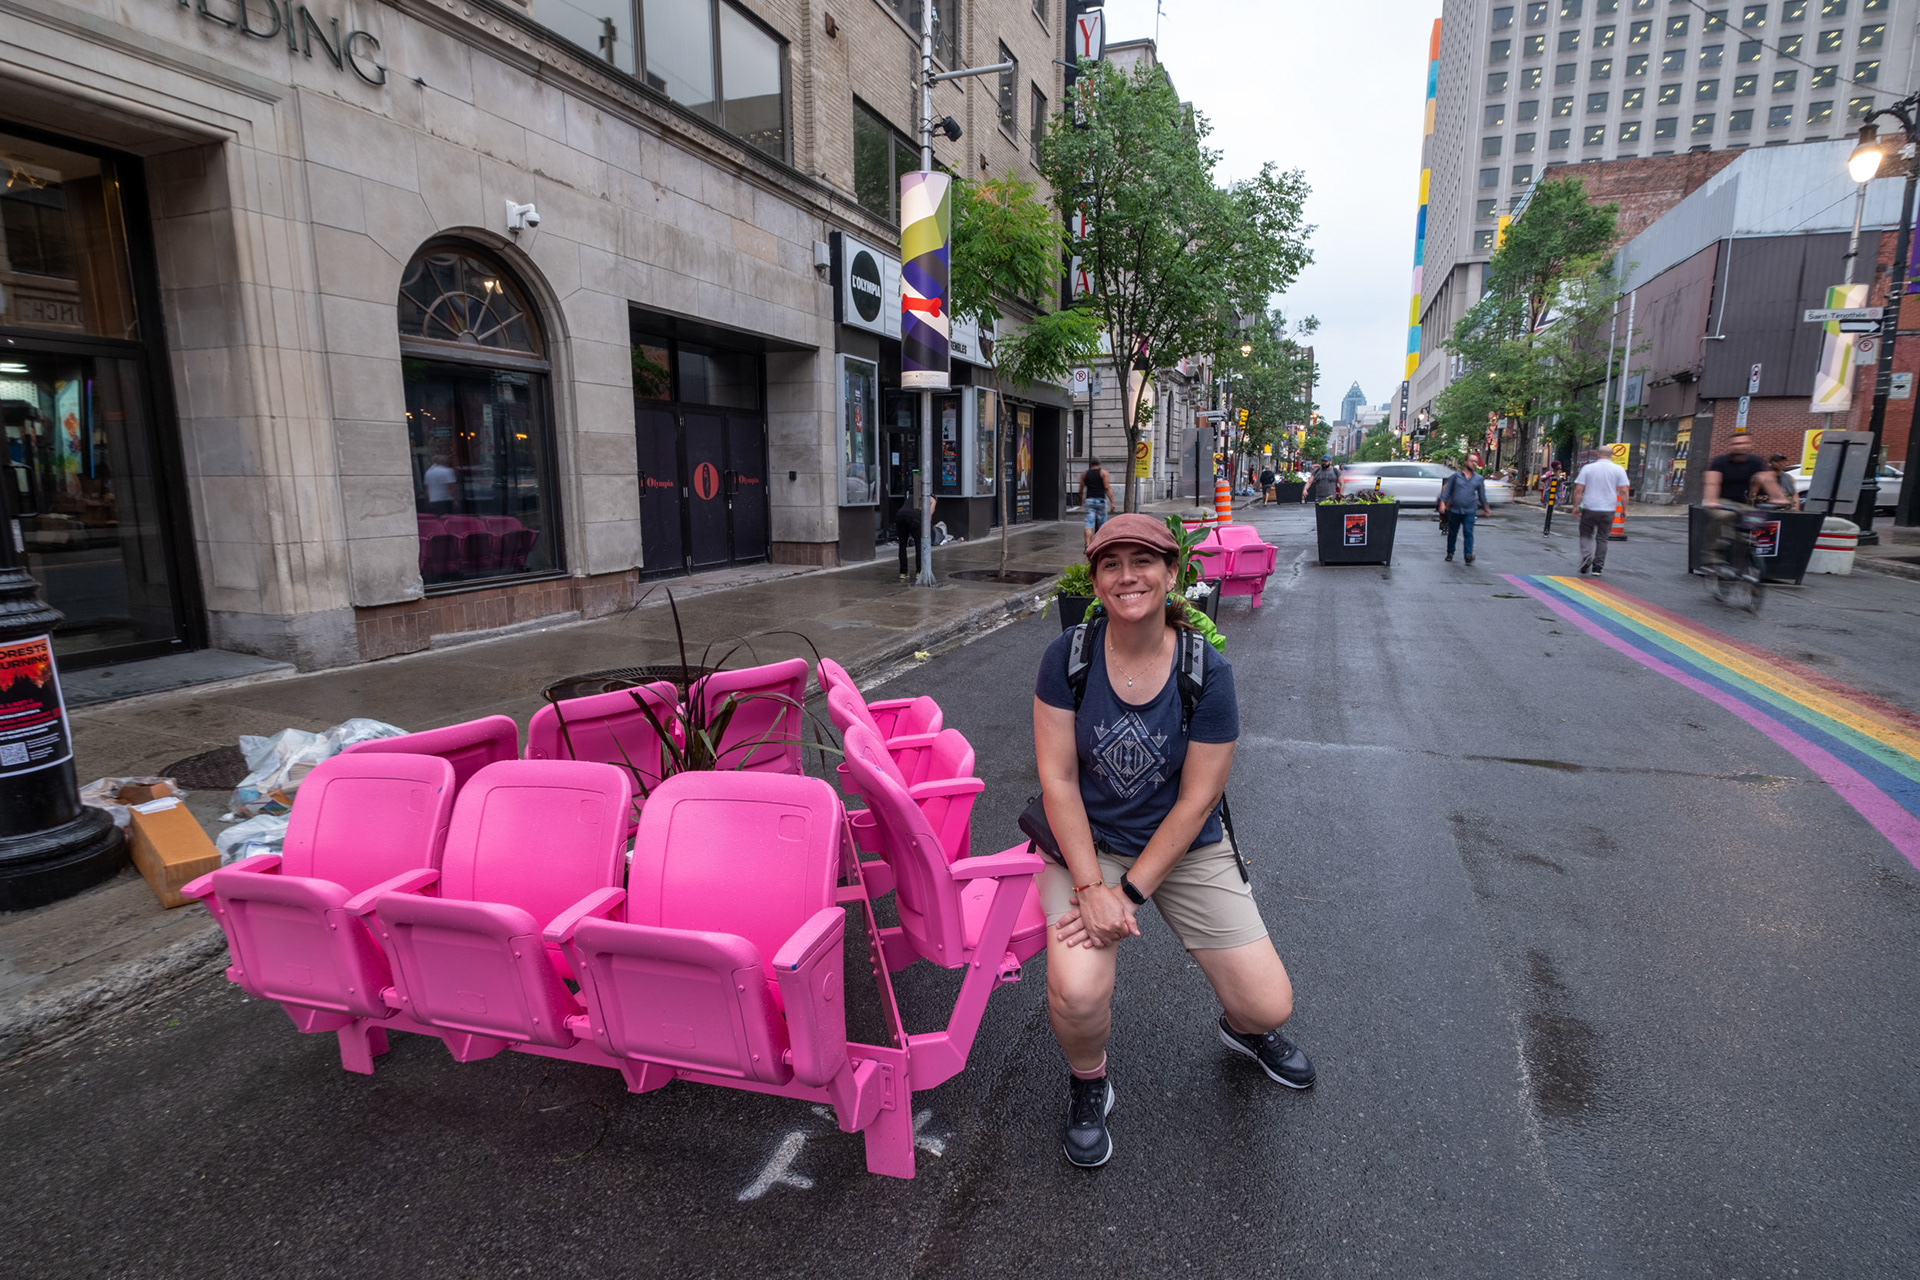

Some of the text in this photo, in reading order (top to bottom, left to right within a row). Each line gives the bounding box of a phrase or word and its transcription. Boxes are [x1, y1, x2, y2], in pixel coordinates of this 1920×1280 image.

[179, 0, 387, 86] LDING
[1808, 312, 1867, 320] Saint-Timothée
[0, 653, 49, 670] URNING
